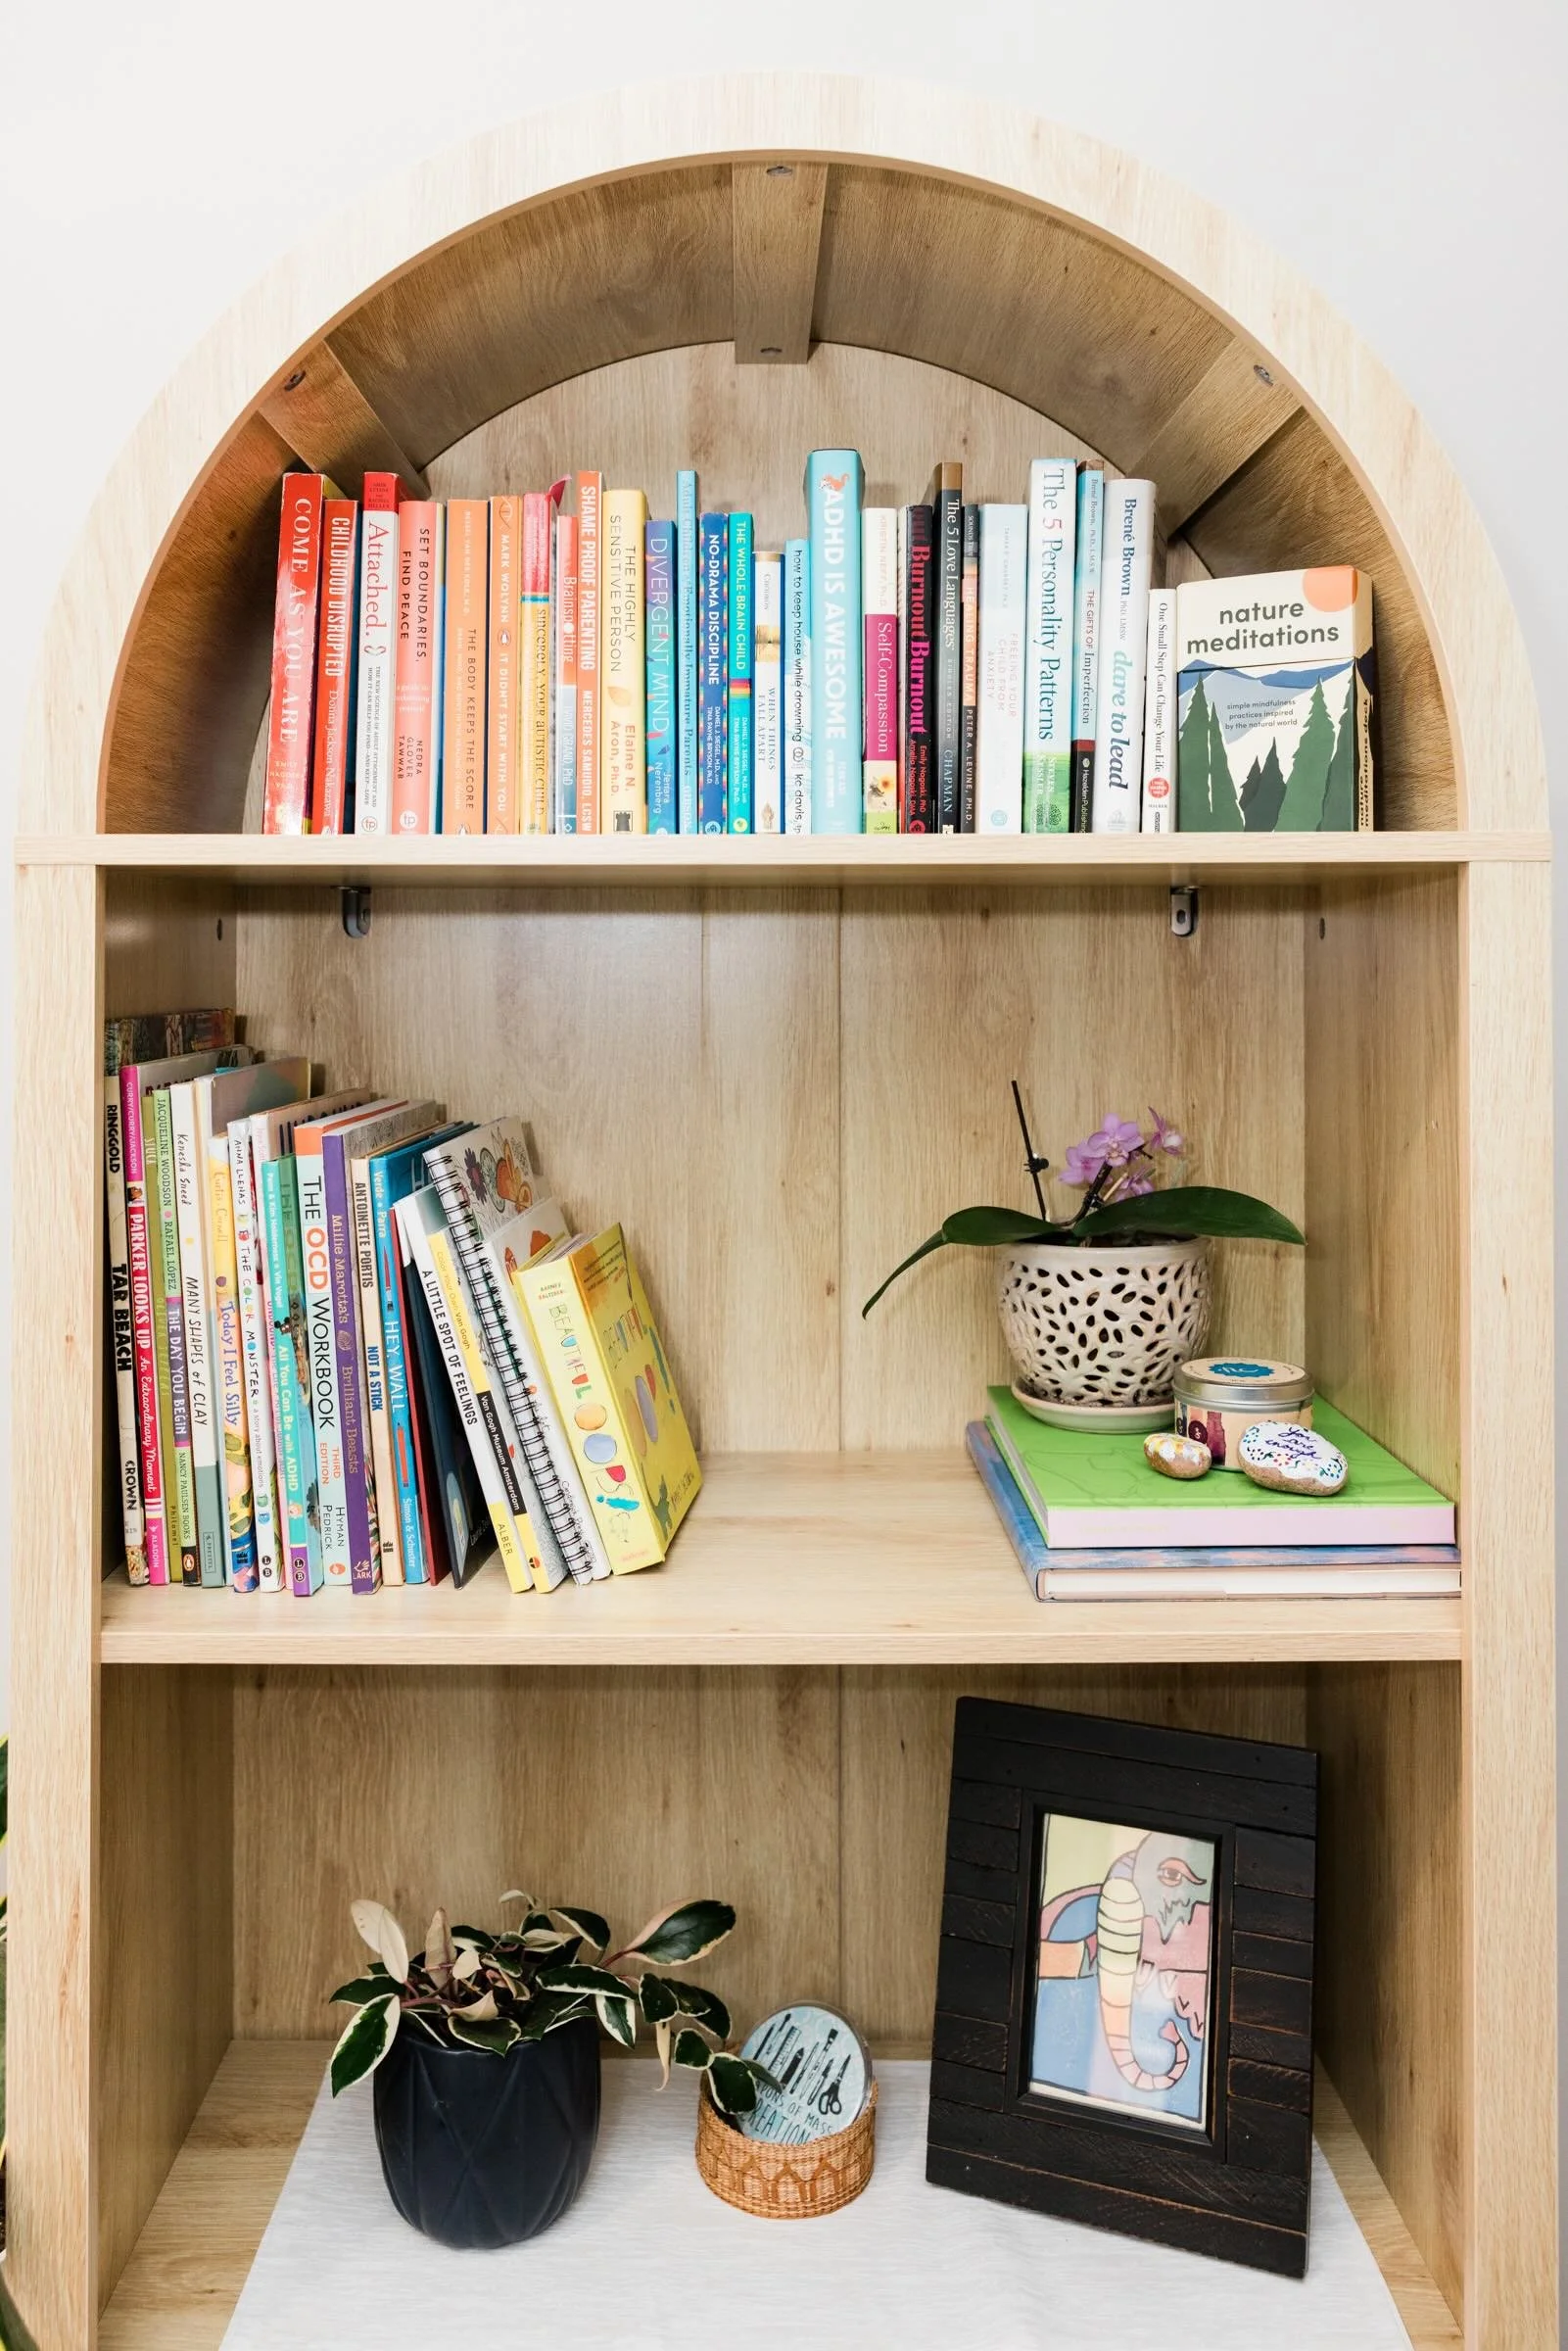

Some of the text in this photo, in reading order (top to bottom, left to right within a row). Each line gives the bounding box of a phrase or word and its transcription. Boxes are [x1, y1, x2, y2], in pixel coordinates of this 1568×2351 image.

[290, 498, 313, 573] COME
[824, 489, 845, 564] ADHD
[287, 581, 308, 615] AS
[325, 517, 351, 678] CHILDHOOD DISRUPTED
[366, 521, 390, 637] Attached.
[401, 551, 411, 640] FIND PEACE
[415, 529, 429, 662] SET BOUNDARIES,
[499, 534, 511, 623] MARK WOLYNN
[579, 485, 596, 671] SHAME PROOF PARENTING
[610, 515, 622, 672] SENSITIVE PERSON
[624, 546, 637, 642] THE HIGHLY
[708, 534, 721, 686] NO-DRAMA DISCIPLINE
[736, 521, 747, 671] THE WHOLE-BRAIN CHILD
[824, 572, 845, 596] IS
[910, 545, 931, 639] Burnout
[1032, 468, 1066, 741] The 5 Personality Patterns
[1219, 601, 1305, 625] nature
[284, 624, 305, 681] YOU
[650, 538, 670, 733] DIVERGENT MIND
[791, 549, 804, 743] how to keep house while drowning
[825, 600, 847, 739] AWESOME
[964, 587, 975, 700] HEALING TRAUMA
[1081, 589, 1096, 725] THE GIFTS OF Imperfection
[1186, 625, 1340, 654] meditations
[279, 689, 301, 744] ARE
[327, 690, 340, 724] Donna
[465, 628, 477, 810] THE BODY KEEPS THE SCORE
[582, 690, 594, 745] MERCEDES
[874, 621, 894, 753] Self-Compassion
[910, 640, 931, 735] Burnout
[1108, 649, 1134, 791] dare to lead
[1226, 698, 1297, 711] simple mindfulness
[1228, 708, 1294, 721] practices inspired
[1248, 720, 1276, 729] natural
[1277, 718, 1298, 728] world
[325, 725, 338, 764] Jackson
[397, 735, 405, 780] TAWWAB
[624, 724, 637, 792] Elaine N.
[943, 748, 955, 812] CHAPMAN
[581, 802, 593, 833] LCSW
[652, 761, 665, 814] Nerenberg
[662, 772, 673, 804] Jenara
[107, 1104, 122, 1175] RINGGOLD
[126, 1080, 138, 1176] CURRY/CURRY/JACKSON
[157, 1097, 172, 1207] JACQUELINE WOODSON
[176, 1132, 192, 1207] Kenesha Sneed
[373, 1171, 389, 1239] Verde Parra
[165, 1221, 178, 1291] RAFAEL LÓPEZ
[355, 1181, 375, 1290] ANTOINETTE PORTIS
[111, 1262, 133, 1371] TAR BEACH
[129, 1213, 152, 1351] PARKER LOOKS UP
[303, 1175, 336, 1432] THE OCD WORKBOOK
[186, 1275, 208, 1426] MANY SHAPES of CLAY
[219, 1302, 237, 1345] Today
[242, 1247, 260, 1399] THE COLOR MONSTER
[331, 1214, 359, 1476] Millie Marotta's Brilliant Beasts
[421, 1270, 479, 1426] A LITTLE SPOT OF FEELINGS
[548, 1303, 593, 1401] BEAUTIFUL
[224, 1359, 239, 1387] Feel
[224, 1393, 242, 1427] Silly
[367, 1345, 385, 1414] NOT A STICK
[139, 1355, 158, 1492] An Extraordinary Moment
[481, 1395, 523, 1511] Van Gogh Museum Amsterdam
[1265, 1439, 1322, 1460] enough
[1283, 1438, 1314, 1450] are
[124, 1459, 139, 1511] CROWN
[178, 1451, 192, 1540] NANCY PAULSEN BOOKS
[319, 1441, 331, 1486] EDITION
[331, 1446, 342, 1480] THIRD
[150, 1533, 161, 1568] ALADDIN
[322, 1504, 334, 1551] PEDRICK
[335, 1506, 347, 1548] HYMAN
[497, 1523, 513, 1556] ALBER
[787, 2101, 802, 2117] OF
